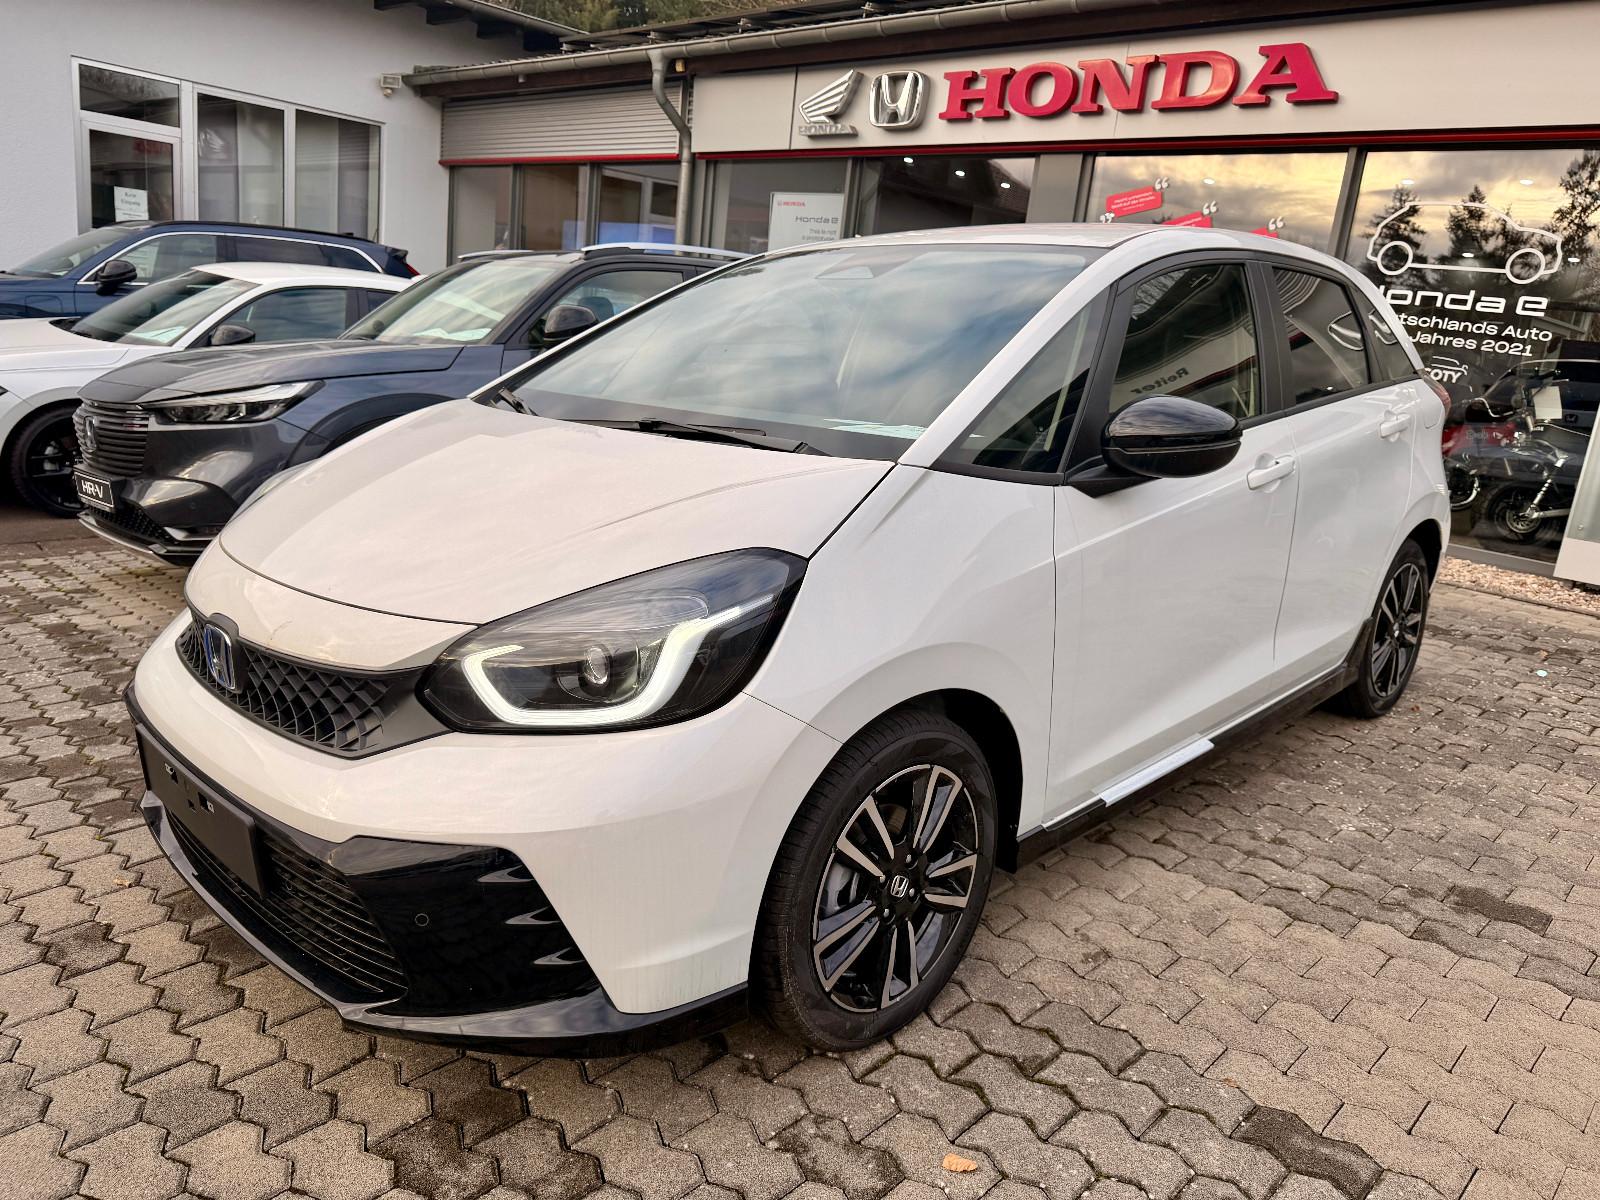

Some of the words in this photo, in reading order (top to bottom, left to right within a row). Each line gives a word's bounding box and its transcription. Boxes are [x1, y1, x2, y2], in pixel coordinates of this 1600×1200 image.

[939, 42, 1339, 121] HONDA
[799, 123, 857, 137] HONDA
[795, 216, 830, 224] Honda
[1380, 285, 1506, 314] onda
[1397, 312, 1499, 336] tschlands
[1501, 325, 1553, 342] Auto
[1409, 331, 1478, 350] Jahres
[1480, 339, 1533, 357] 2021
[81, 479, 103, 499] HR-V
